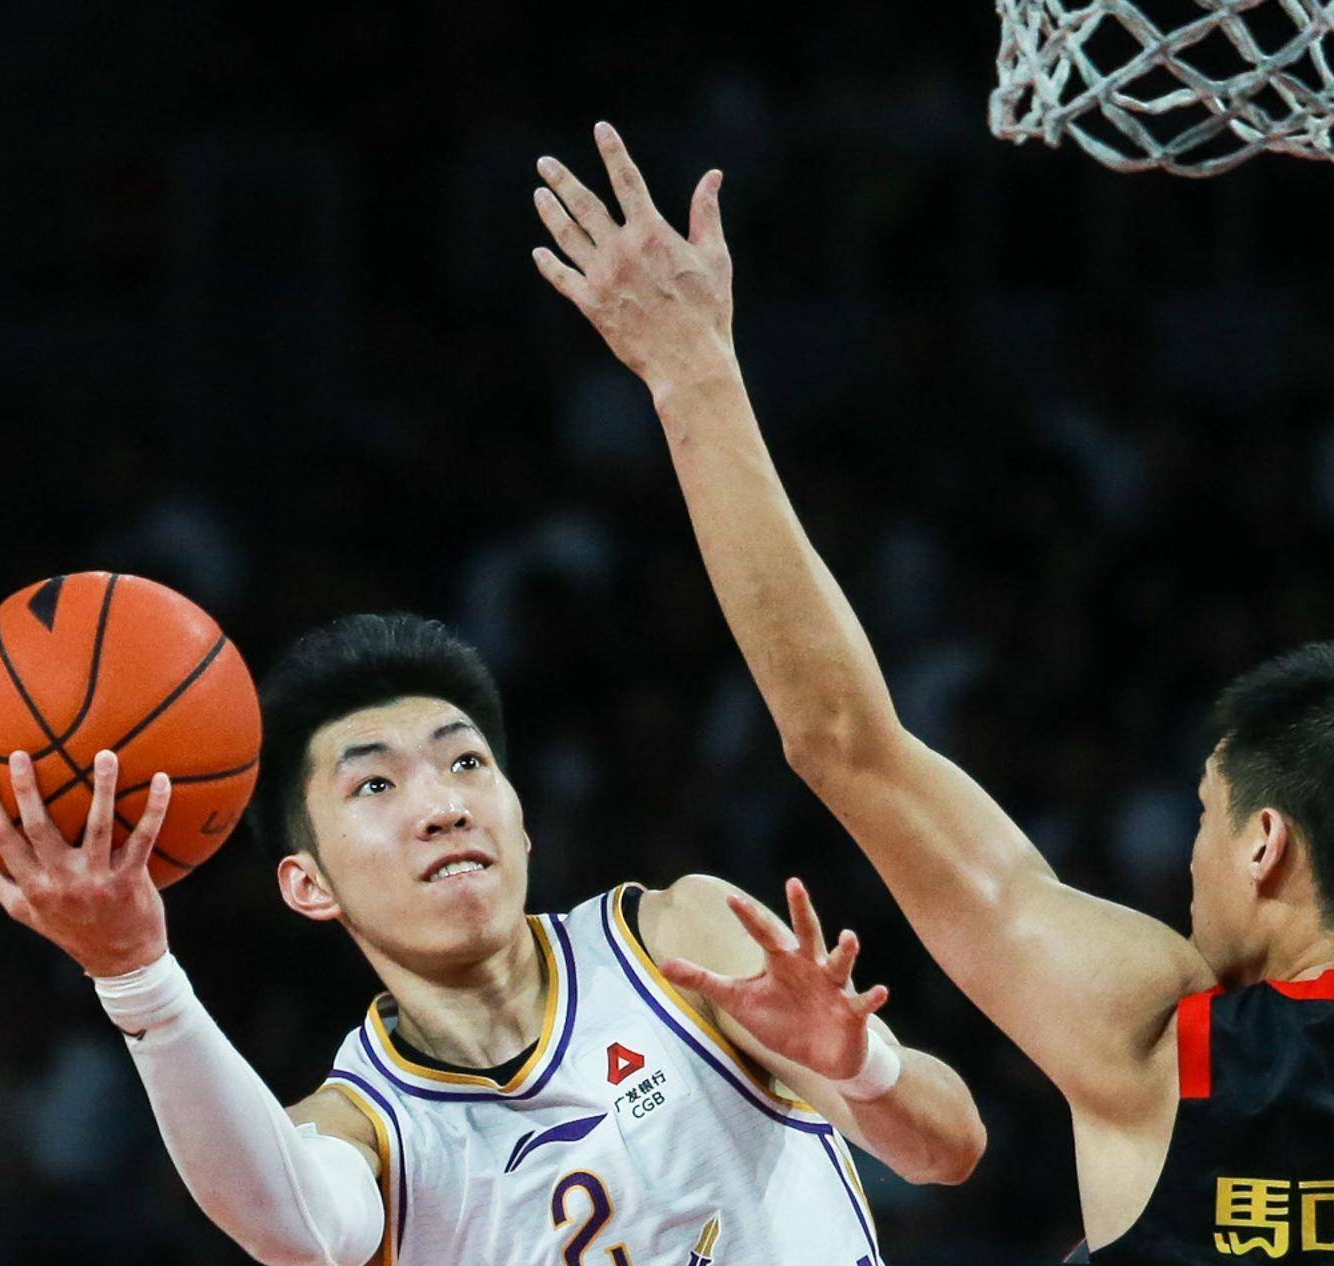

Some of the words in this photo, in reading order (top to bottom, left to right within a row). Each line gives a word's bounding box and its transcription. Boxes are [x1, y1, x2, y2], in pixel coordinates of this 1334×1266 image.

[614, 1070, 666, 1113] 广发银行
[632, 1092, 665, 1119] CGB
